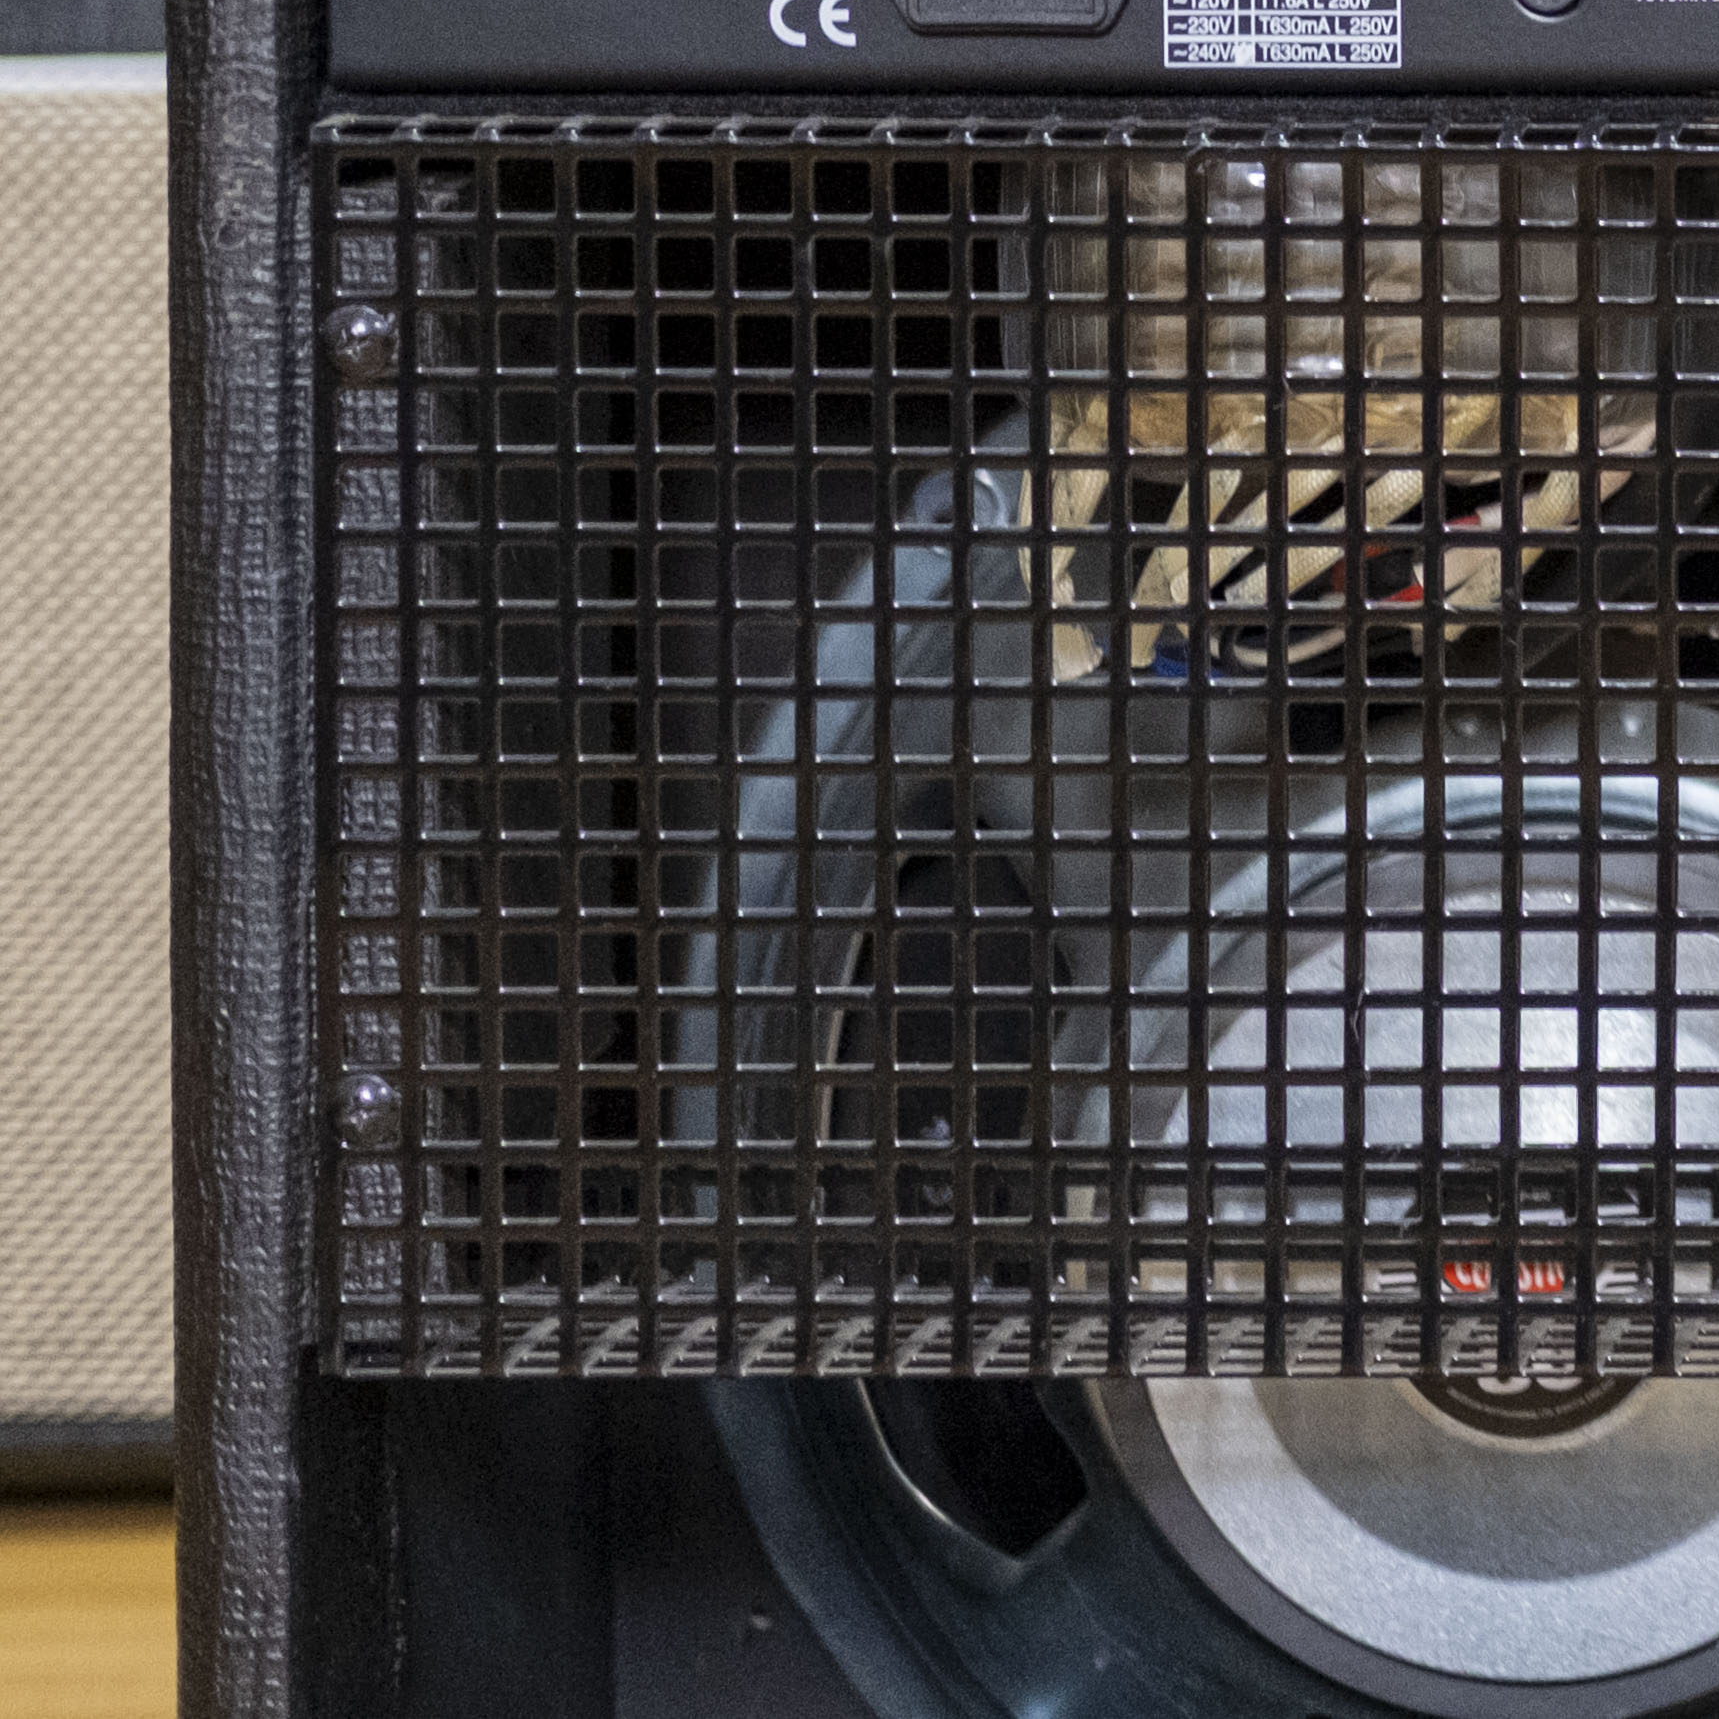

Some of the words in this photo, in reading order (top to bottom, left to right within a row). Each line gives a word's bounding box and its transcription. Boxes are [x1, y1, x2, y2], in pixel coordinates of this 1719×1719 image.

[1258, 17, 1331, 35] T630mA
[1334, 17, 1346, 35] L
[1349, 17, 1394, 35] 250V
[1258, 43, 1331, 61] T630mA
[1334, 43, 1346, 61] L
[1350, 43, 1394, 61] 250V
